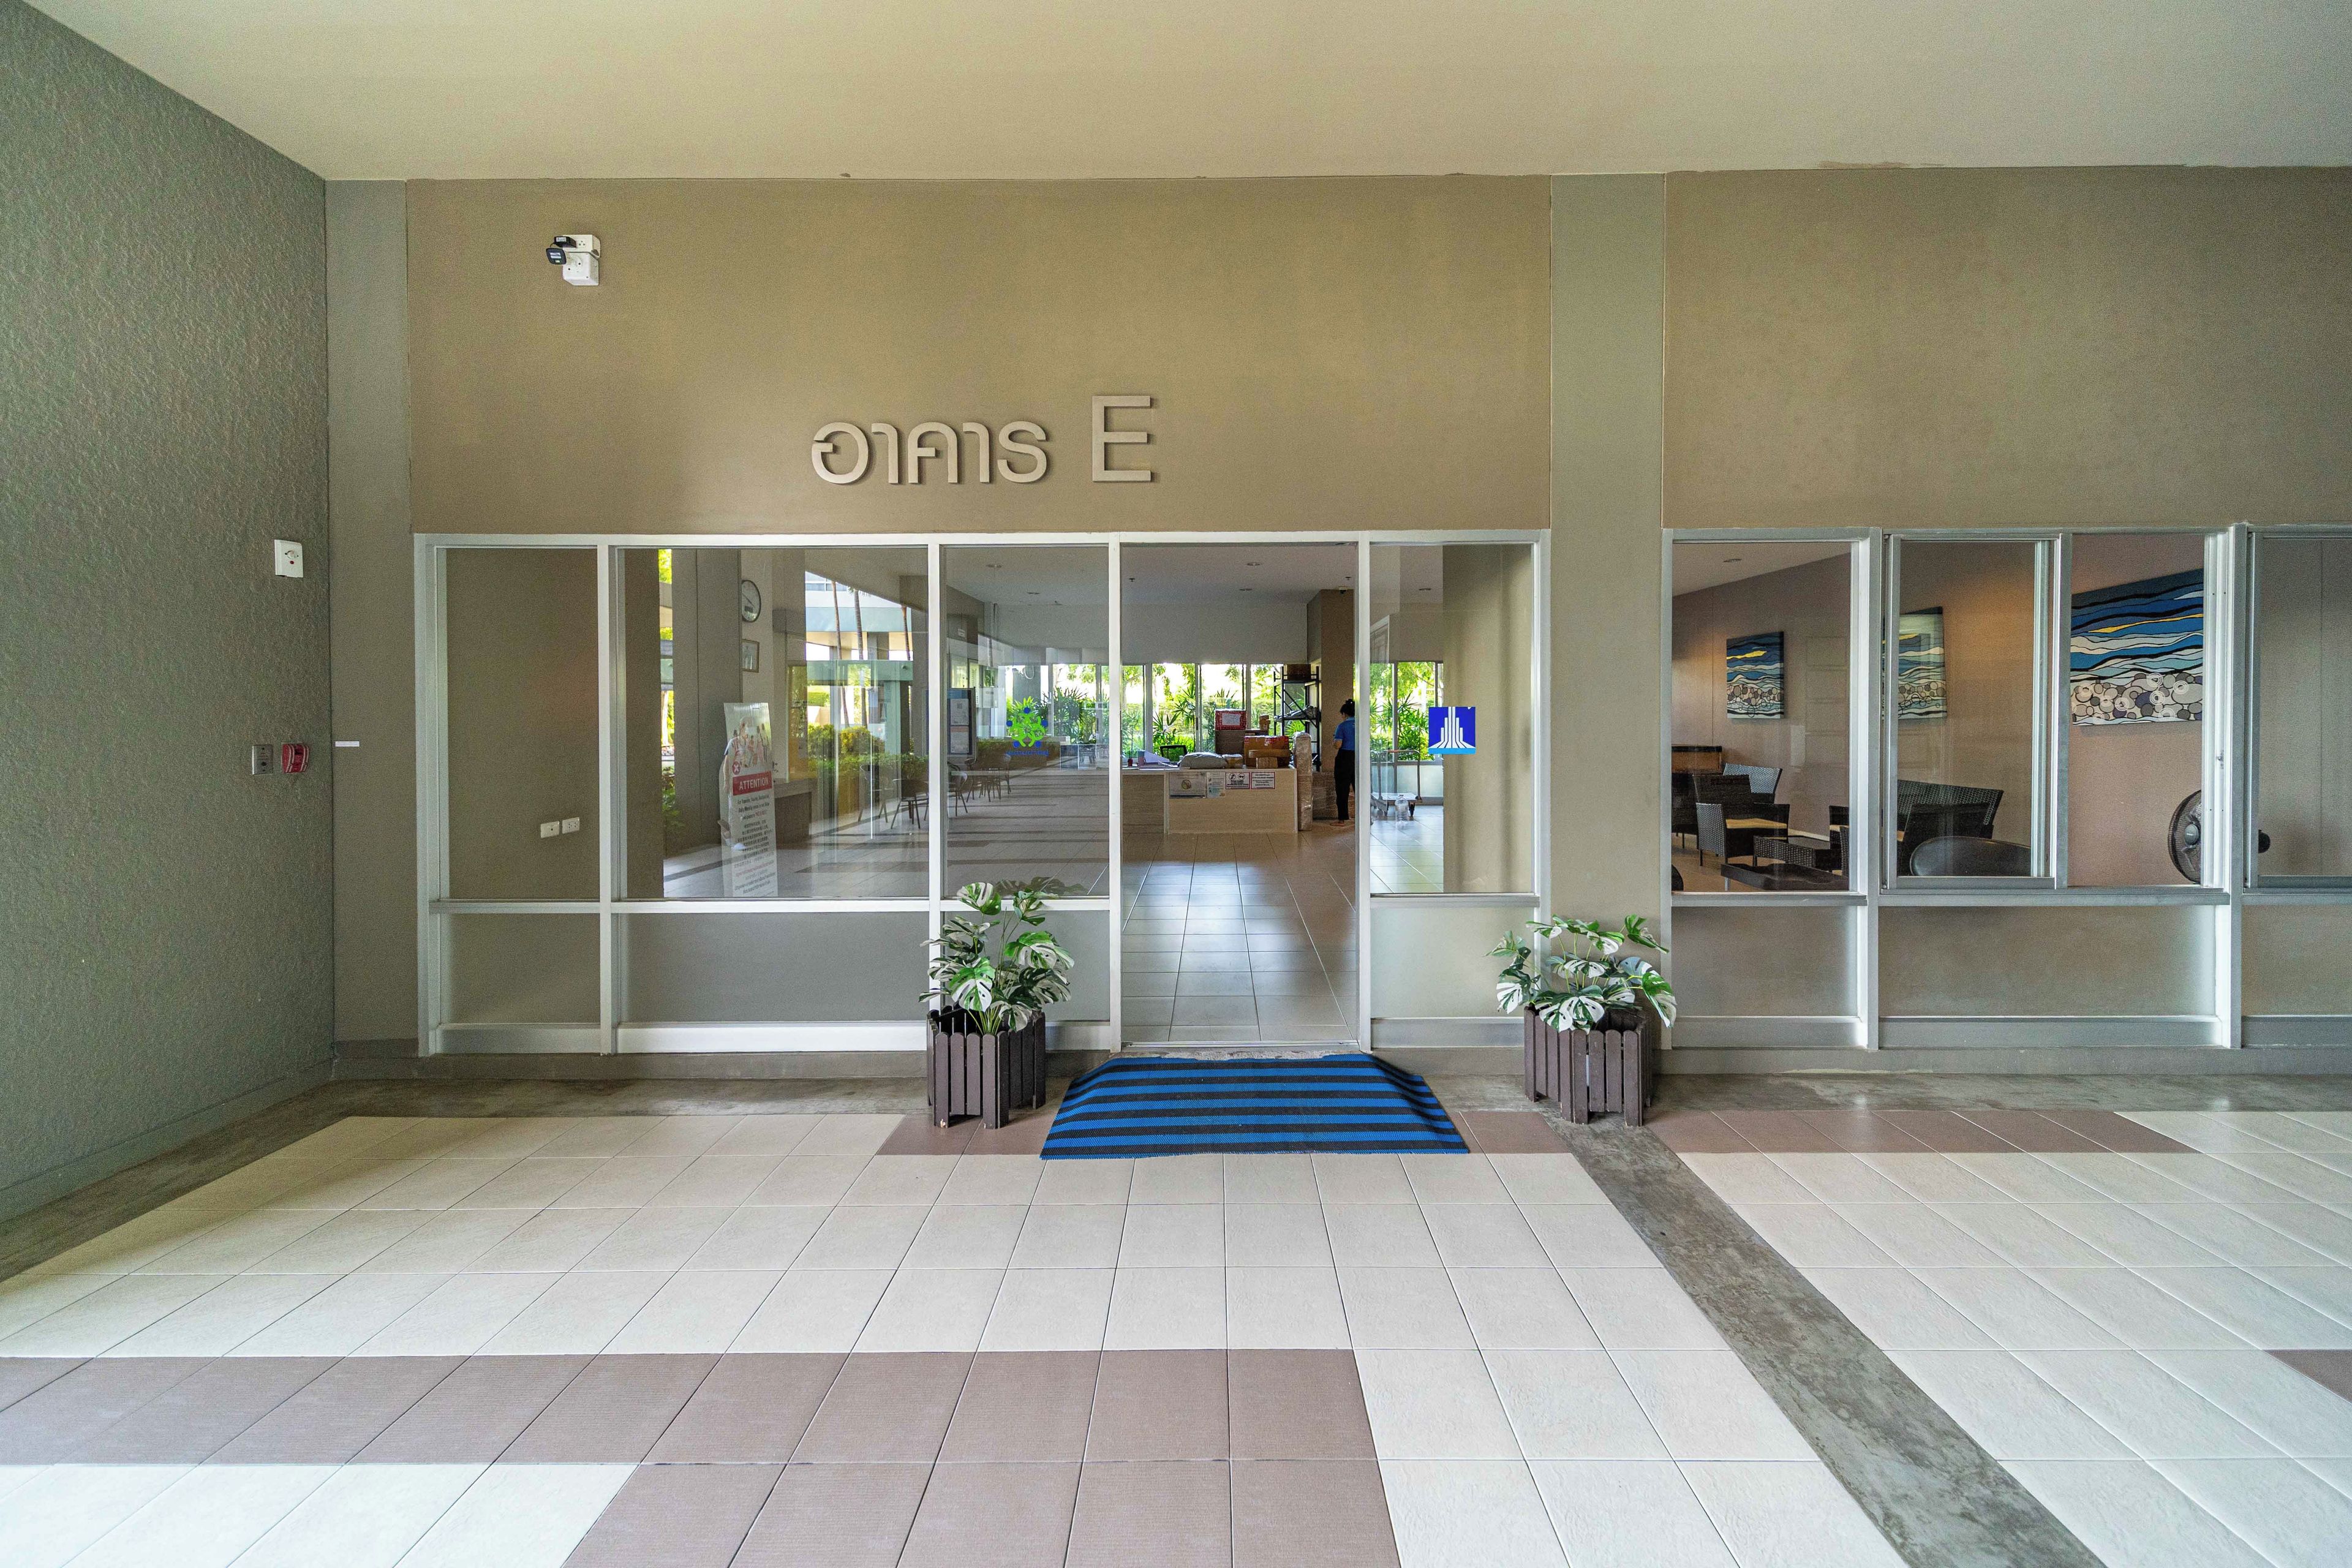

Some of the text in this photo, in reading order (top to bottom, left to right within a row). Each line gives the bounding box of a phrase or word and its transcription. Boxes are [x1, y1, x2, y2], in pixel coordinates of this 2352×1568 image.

[811, 395, 1152, 484] อาคาร E
[739, 777, 769, 791] ATTENTION
